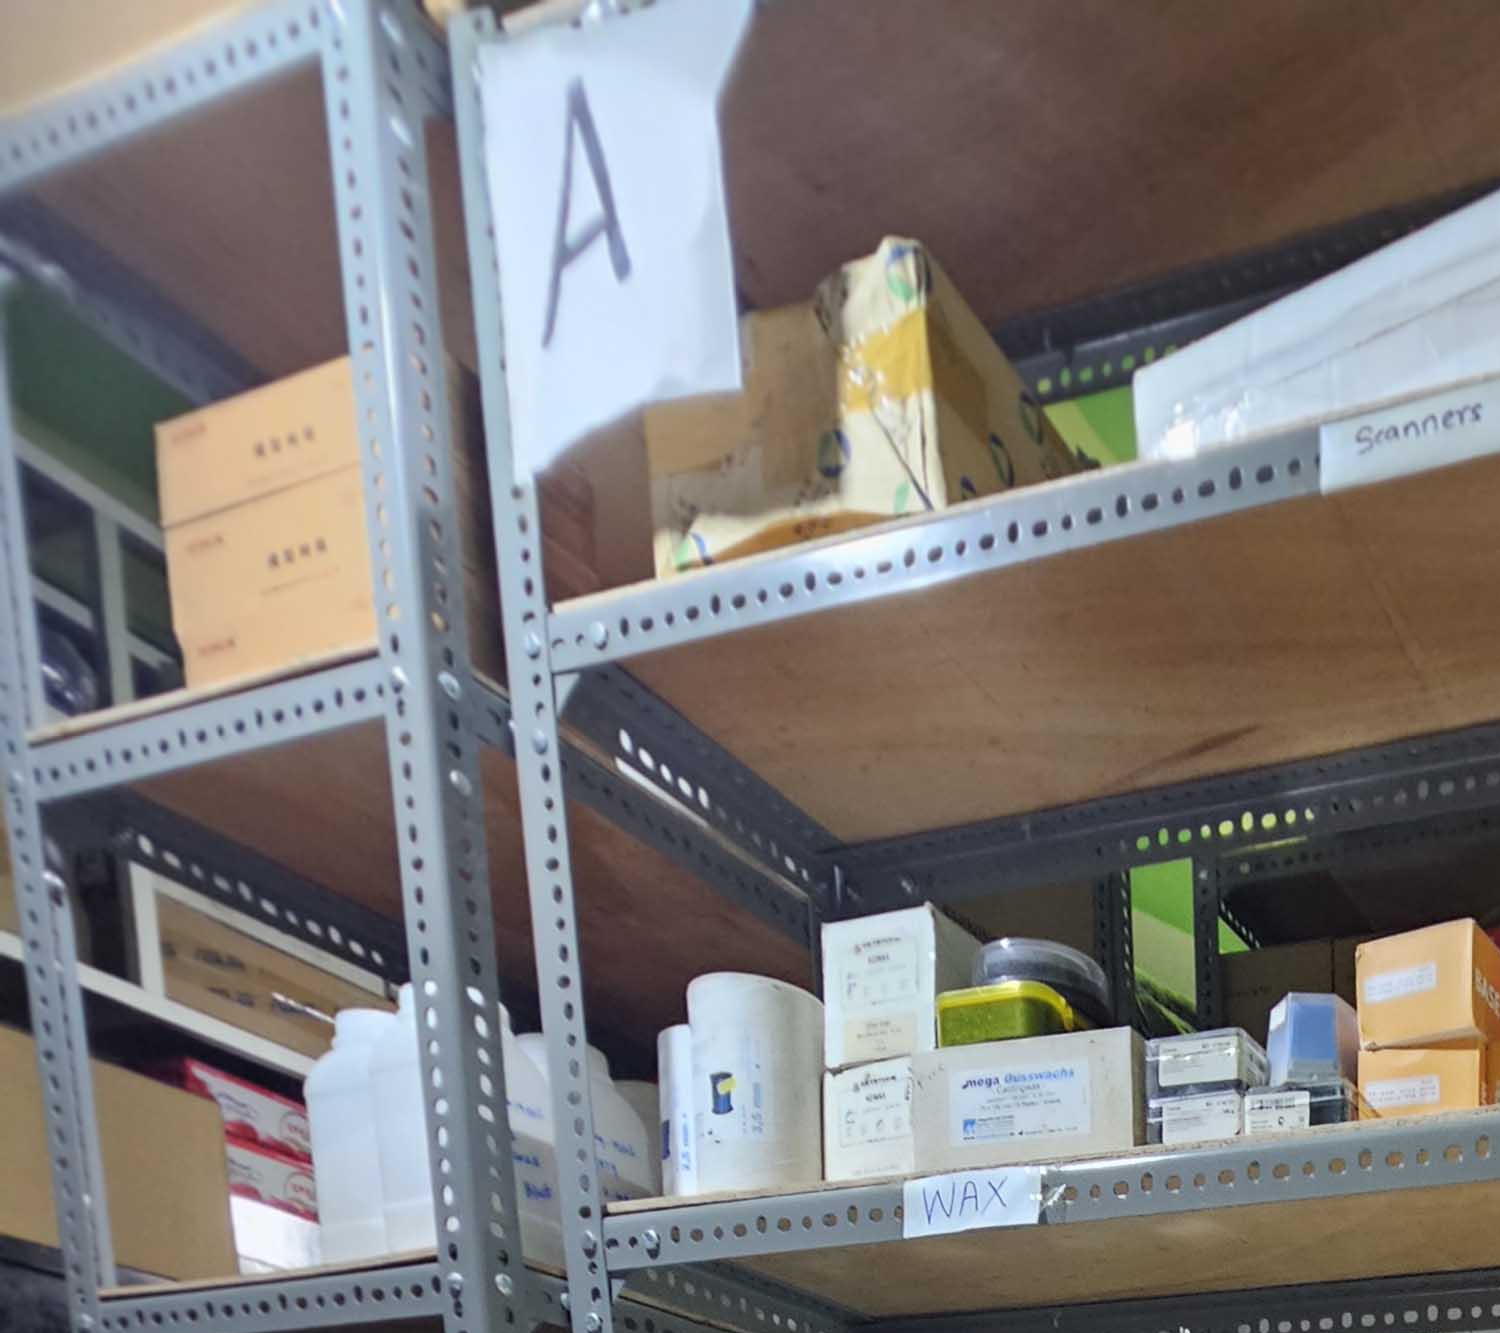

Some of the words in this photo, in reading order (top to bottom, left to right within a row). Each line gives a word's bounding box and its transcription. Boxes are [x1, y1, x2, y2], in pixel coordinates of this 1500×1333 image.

[541, 76, 631, 348] A
[1355, 403, 1483, 455] Scanners
[962, 1077, 1000, 1089] mega
[923, 1177, 1010, 1225] WAX
